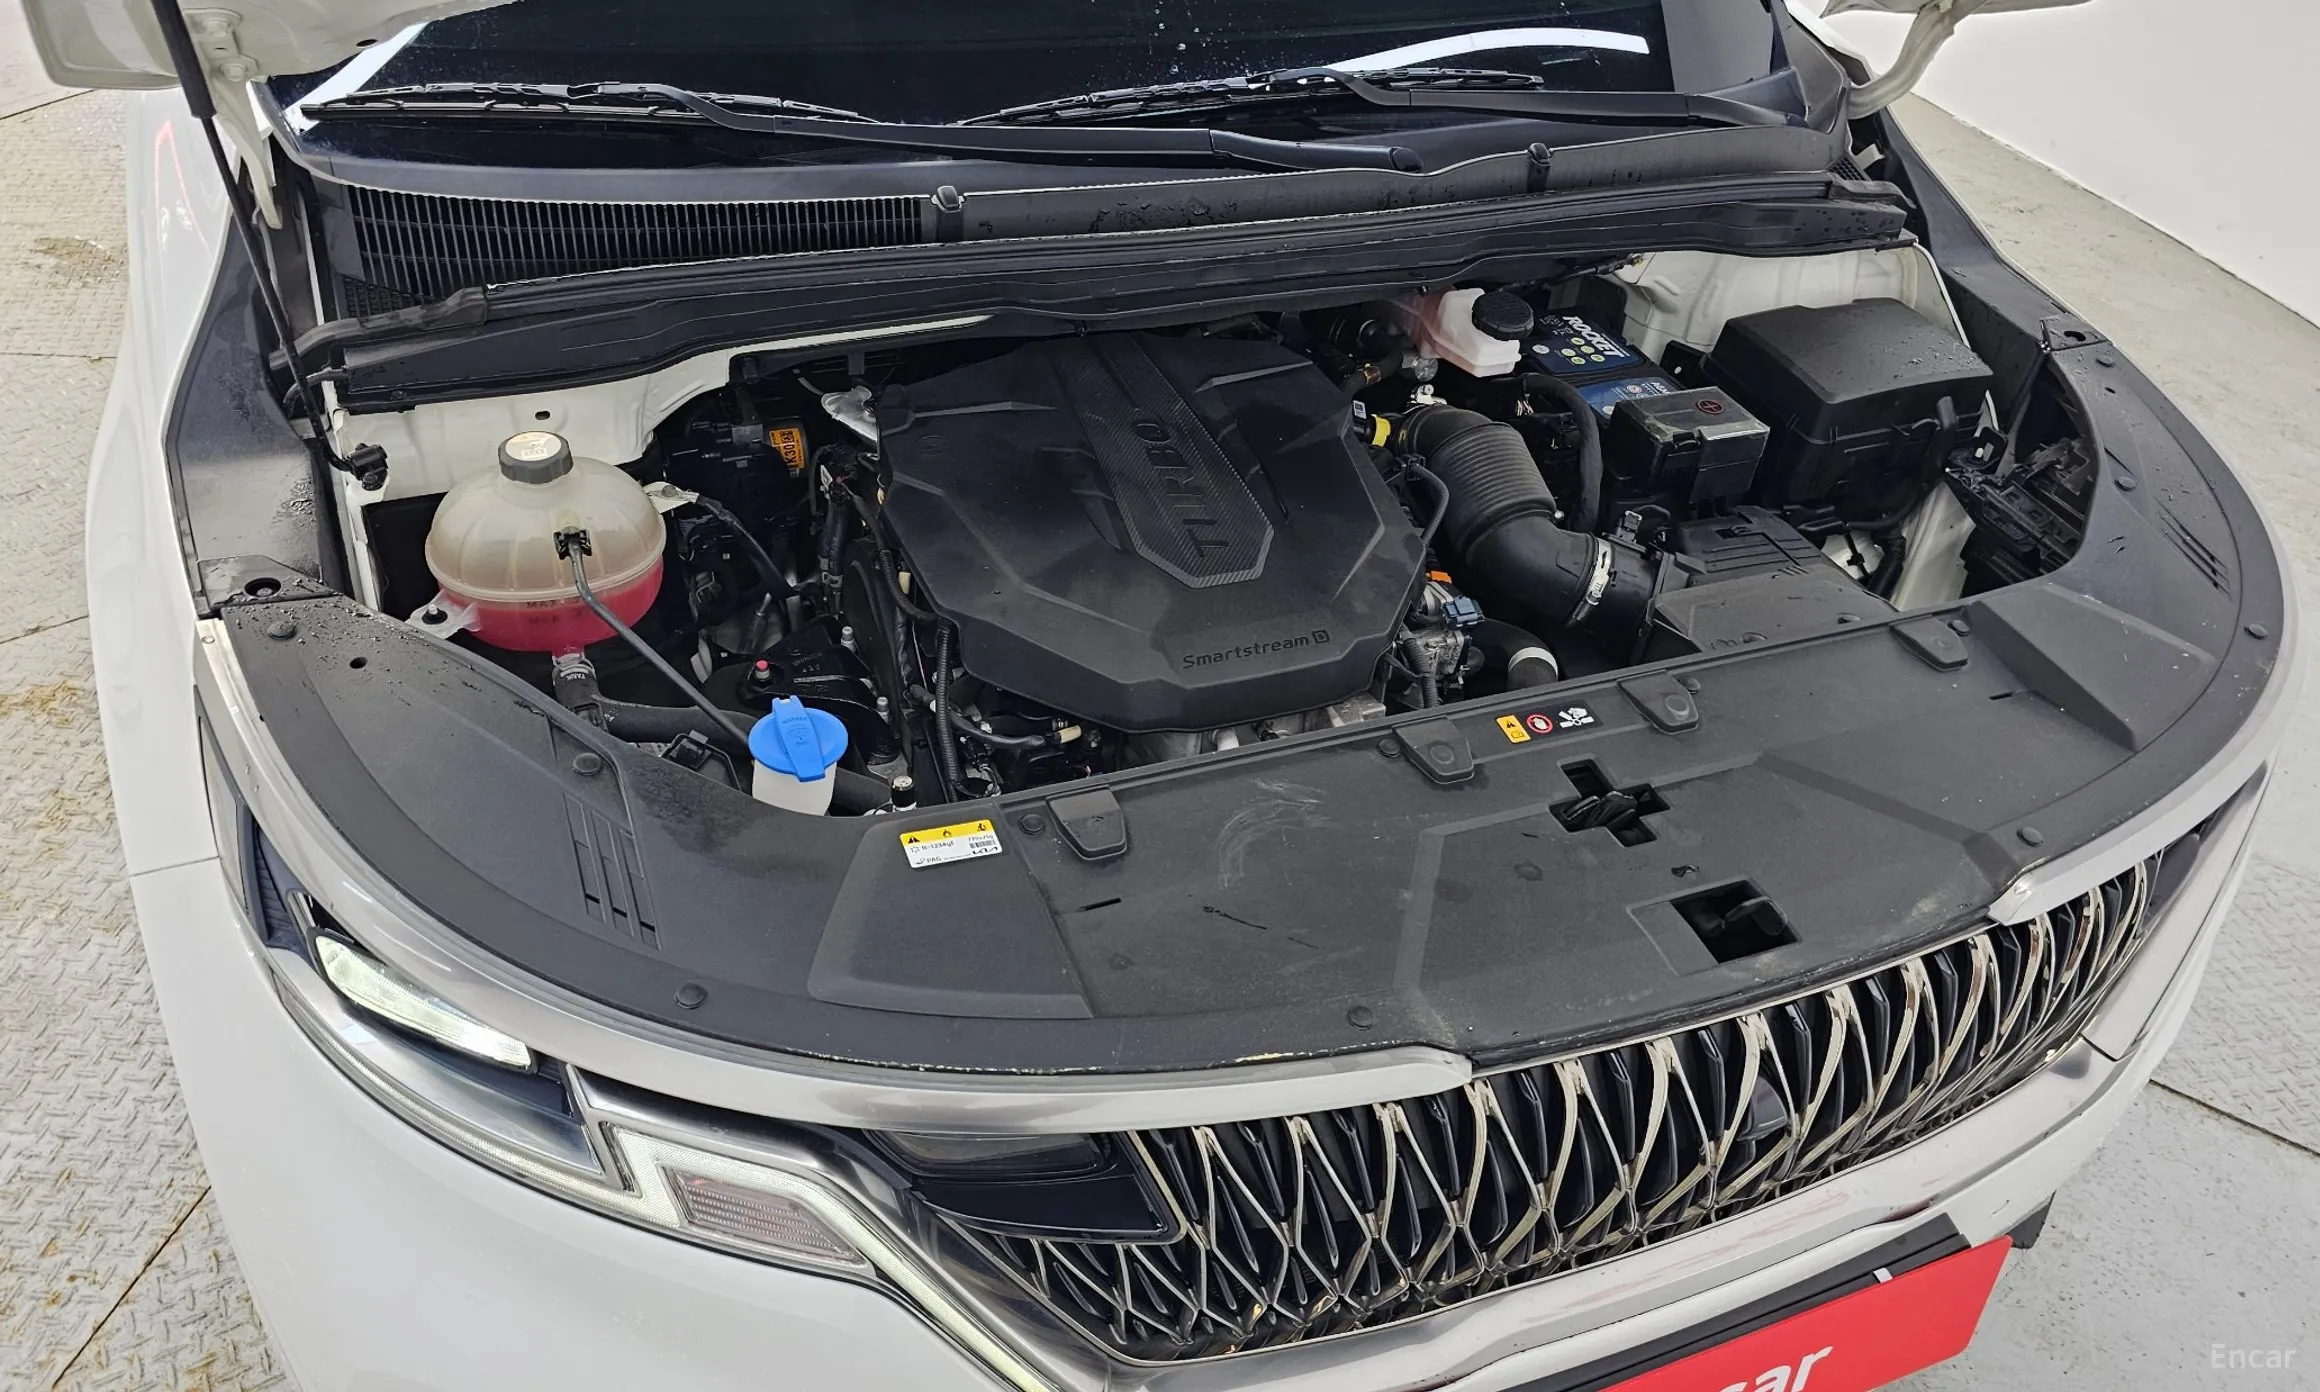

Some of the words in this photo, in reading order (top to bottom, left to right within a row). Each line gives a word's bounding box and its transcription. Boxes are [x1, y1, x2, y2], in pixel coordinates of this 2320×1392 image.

[1562, 315, 1625, 358] ROCKET
[1131, 421, 1230, 558] TURBO
[1182, 635, 1309, 669] Smartstream
